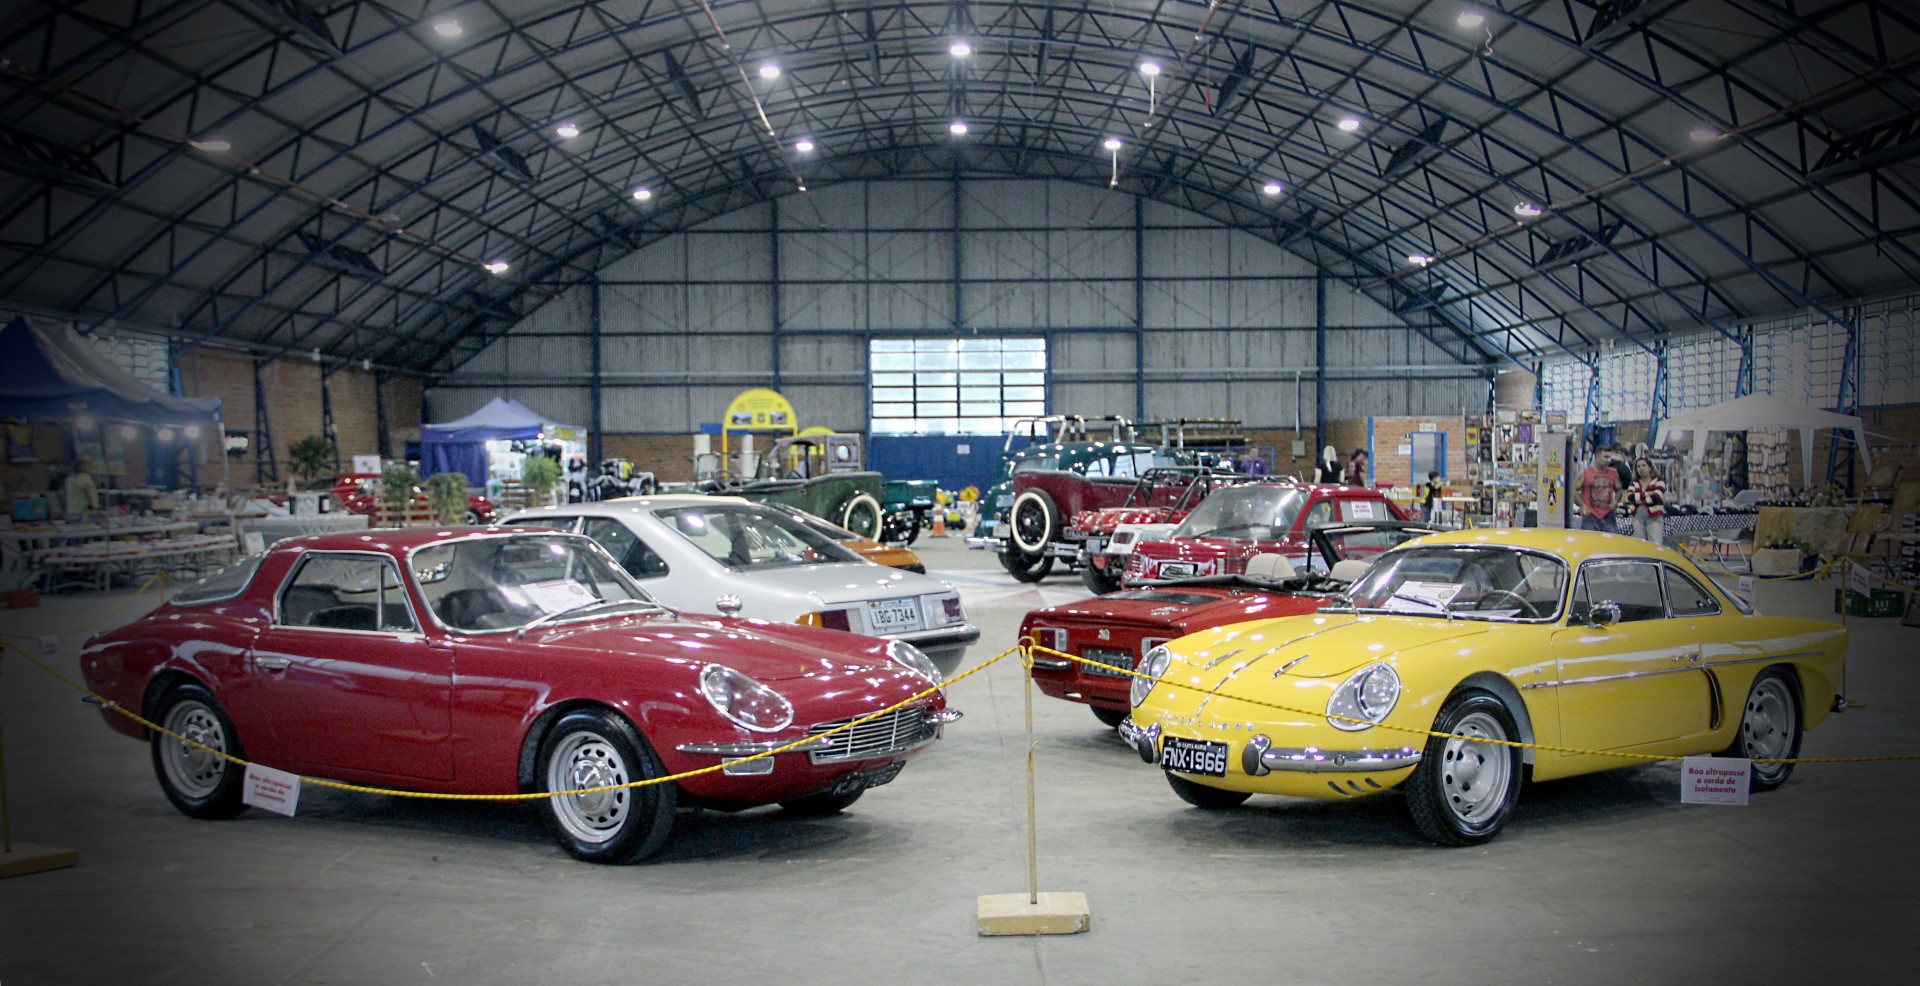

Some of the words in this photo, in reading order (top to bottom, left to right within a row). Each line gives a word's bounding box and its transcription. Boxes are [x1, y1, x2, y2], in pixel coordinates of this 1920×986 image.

[1705, 768, 1745, 777] ultrapasse
[1703, 777, 1725, 785] corda
[1726, 777, 1736, 785] de
[1694, 784, 1737, 794] isolamento
